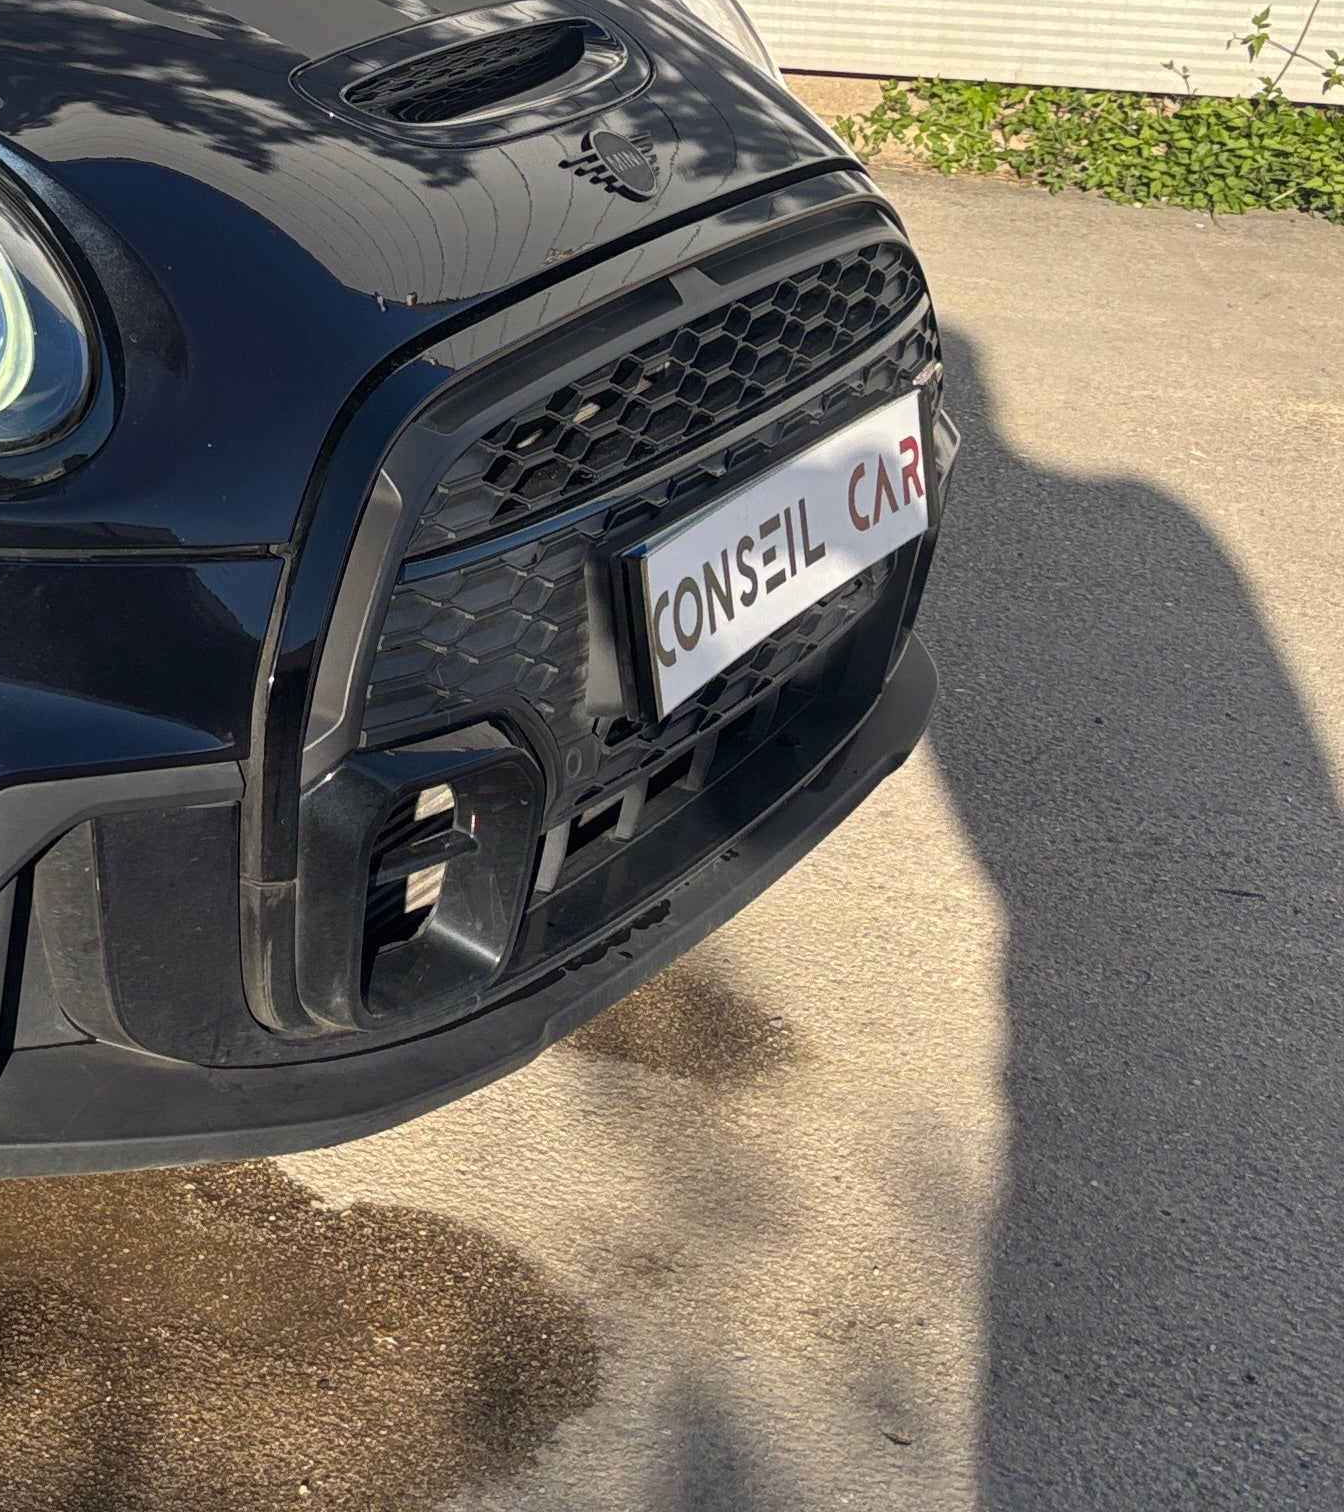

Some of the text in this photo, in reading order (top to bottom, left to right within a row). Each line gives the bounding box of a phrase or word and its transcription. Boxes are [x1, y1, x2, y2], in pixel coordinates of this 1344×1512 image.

[605, 150, 642, 173] MINI
[653, 436, 924, 667] CONSEIL CAR
